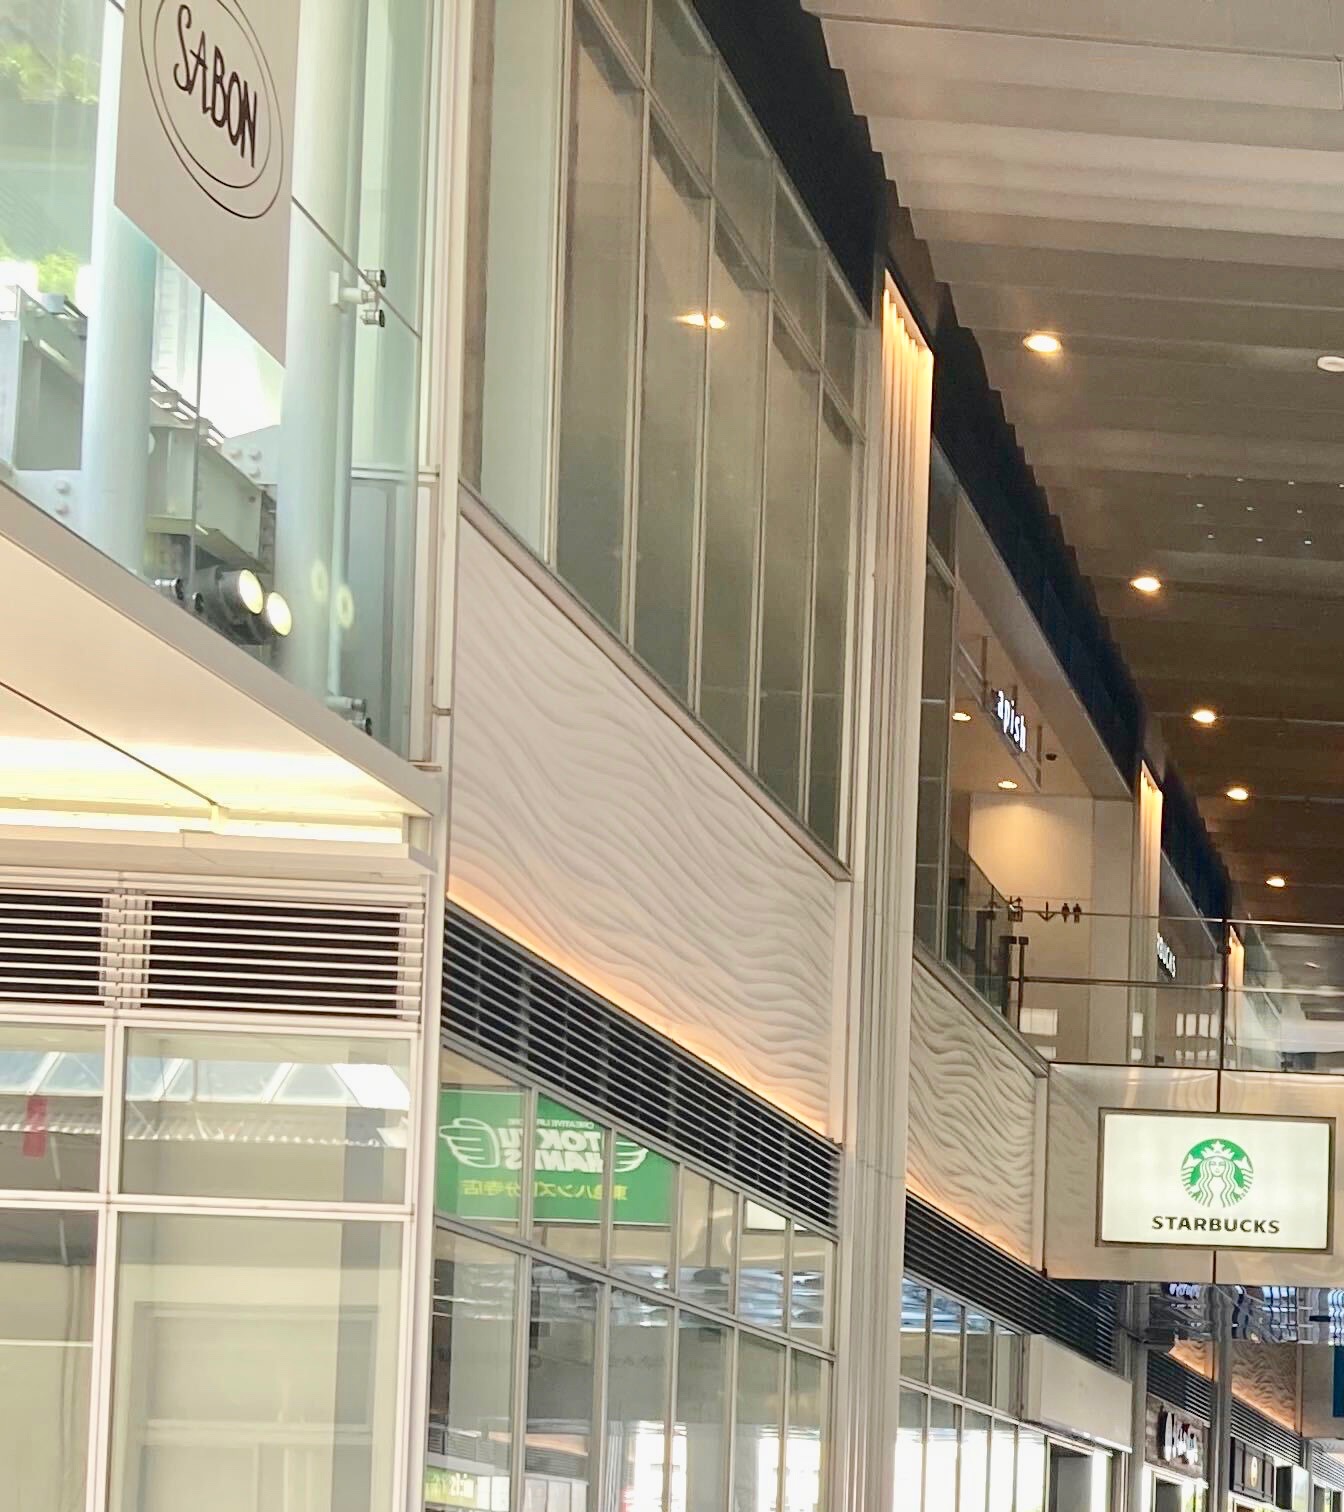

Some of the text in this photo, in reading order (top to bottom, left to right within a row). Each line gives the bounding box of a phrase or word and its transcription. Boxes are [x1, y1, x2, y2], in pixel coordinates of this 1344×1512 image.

[173, 4, 258, 169] SABON
[996, 690, 1027, 752] apish
[1151, 1215, 1280, 1234] STARBUCKS
